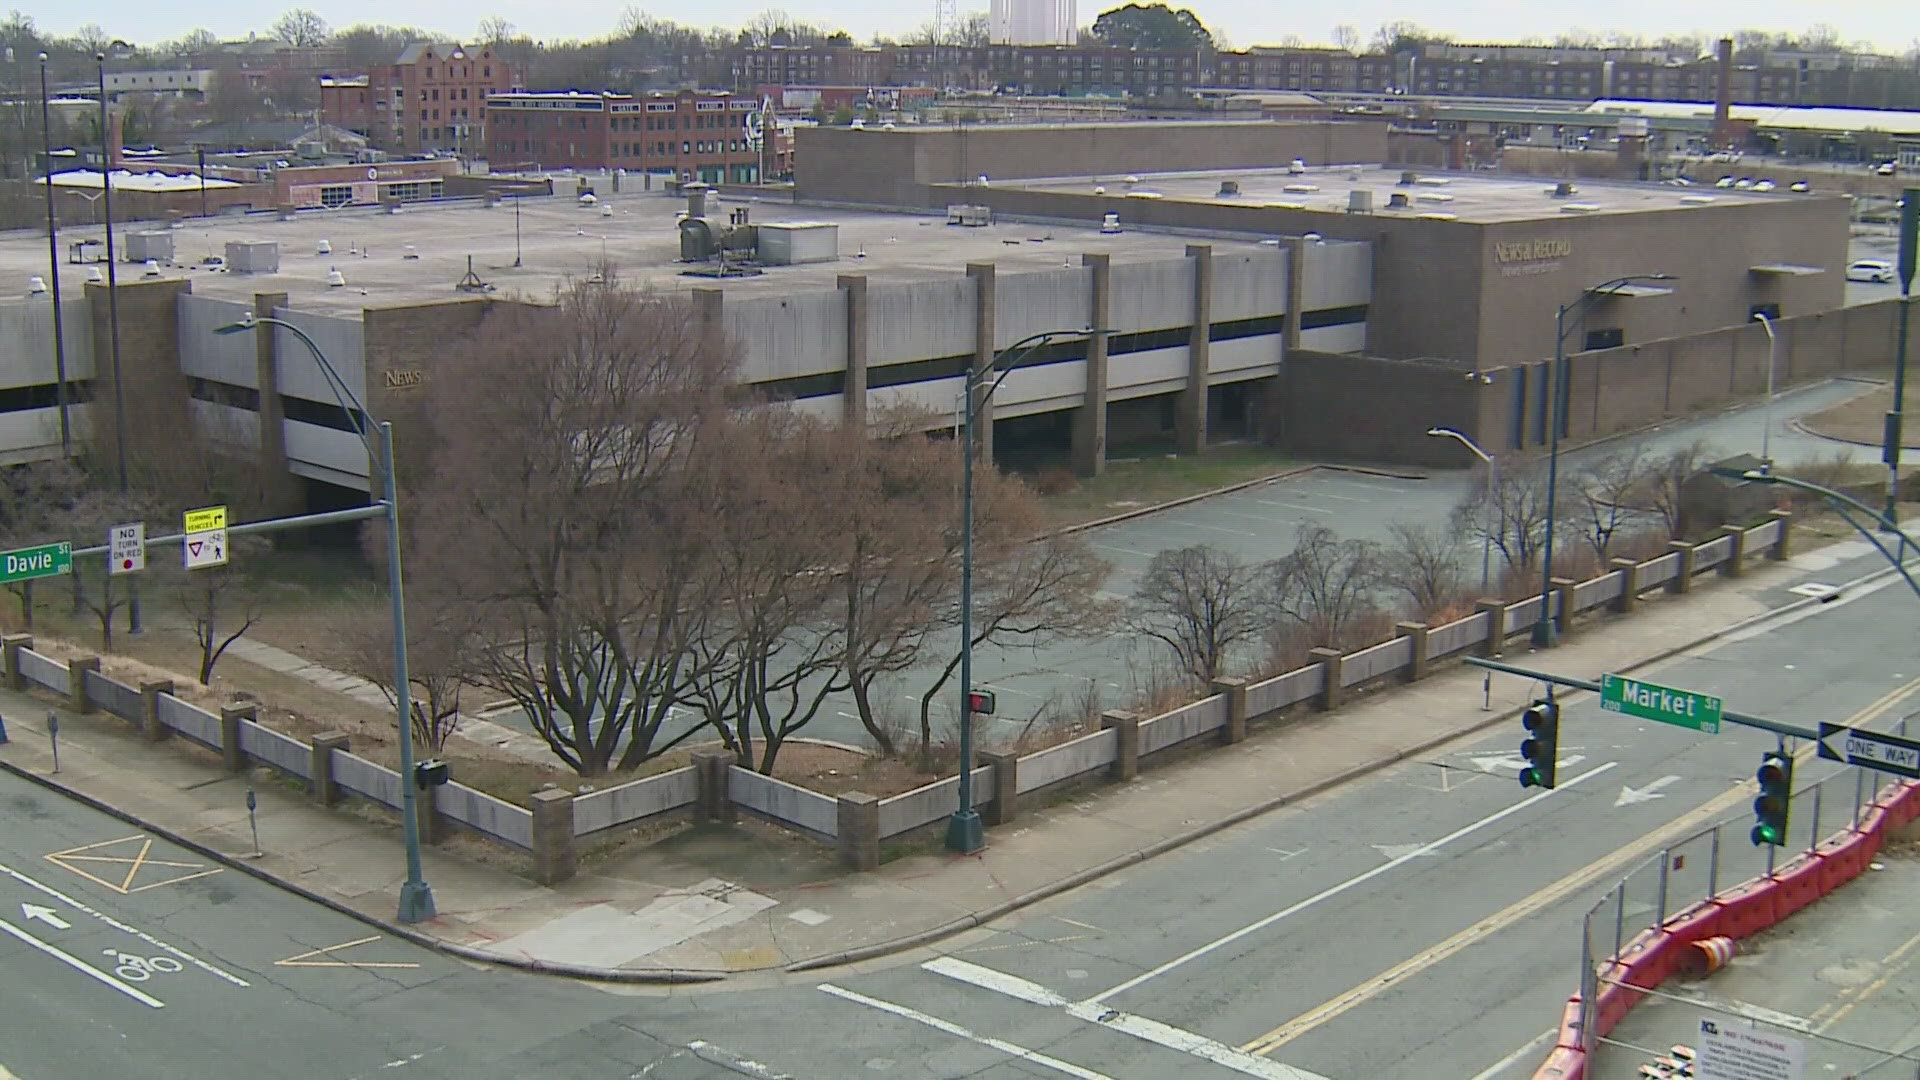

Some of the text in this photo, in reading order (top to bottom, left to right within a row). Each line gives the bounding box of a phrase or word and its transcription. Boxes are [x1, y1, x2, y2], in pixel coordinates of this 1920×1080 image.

[189, 514, 211, 522] TURNING
[120, 529, 135, 538] NO
[118, 540, 138, 549] TURN
[127, 548, 142, 557] RED
[7, 552, 52, 574] Davie
[1604, 674, 1612, 687] E
[1622, 681, 1695, 716] Market
[1845, 738, 1915, 764] ONE WAY
